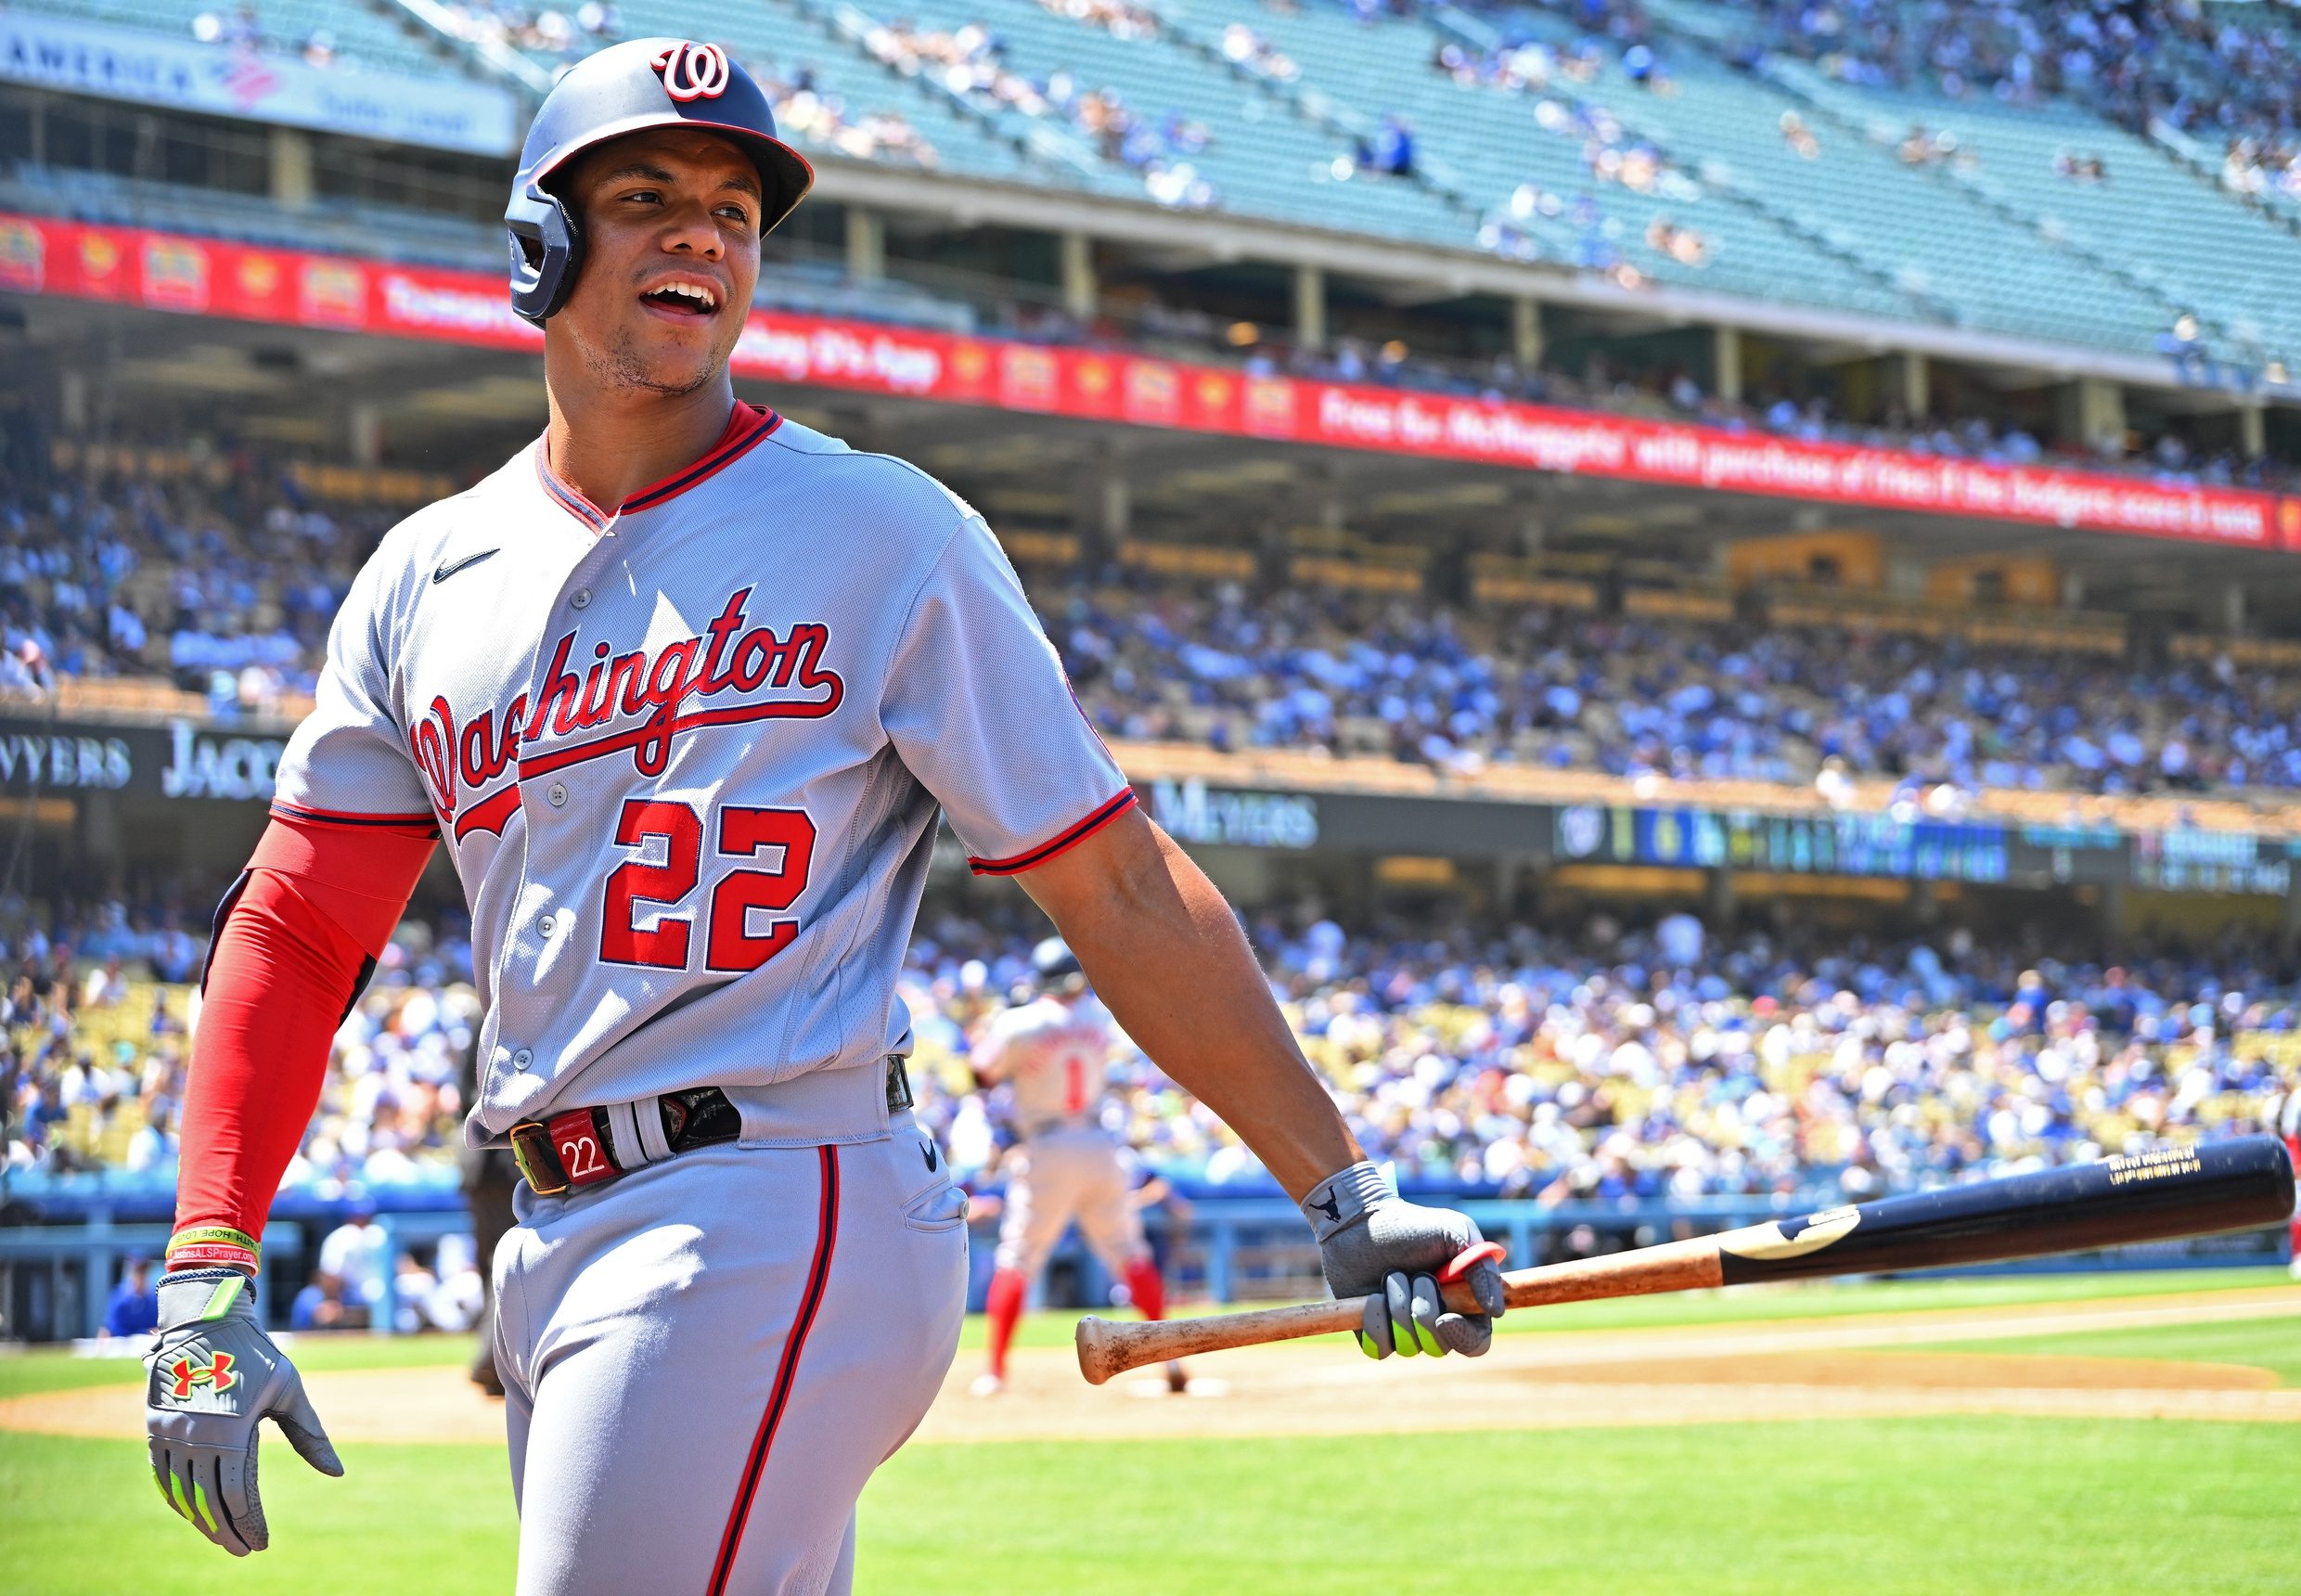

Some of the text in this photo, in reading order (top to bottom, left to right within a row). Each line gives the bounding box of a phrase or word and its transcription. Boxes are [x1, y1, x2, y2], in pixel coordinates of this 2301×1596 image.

[409, 582, 844, 826] Washington
[597, 796, 817, 974] 22
[562, 1137, 604, 1178] 22
